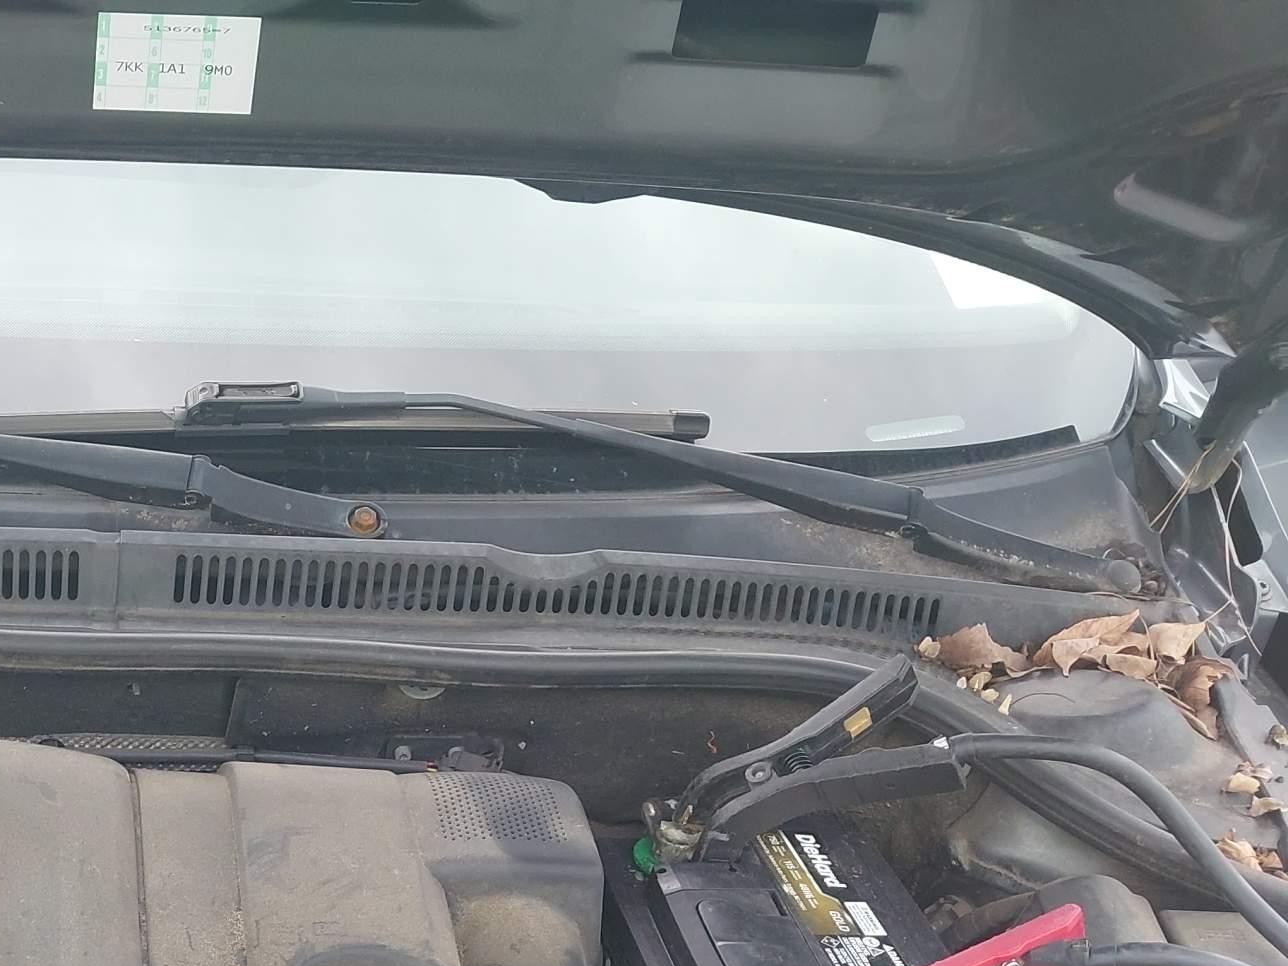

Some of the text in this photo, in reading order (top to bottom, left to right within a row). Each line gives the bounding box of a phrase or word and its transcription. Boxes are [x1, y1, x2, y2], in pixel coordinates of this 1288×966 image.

[115, 61, 144, 73] 7KK
[794, 833, 848, 888] DieHard
[829, 910, 851, 932] GOLD
